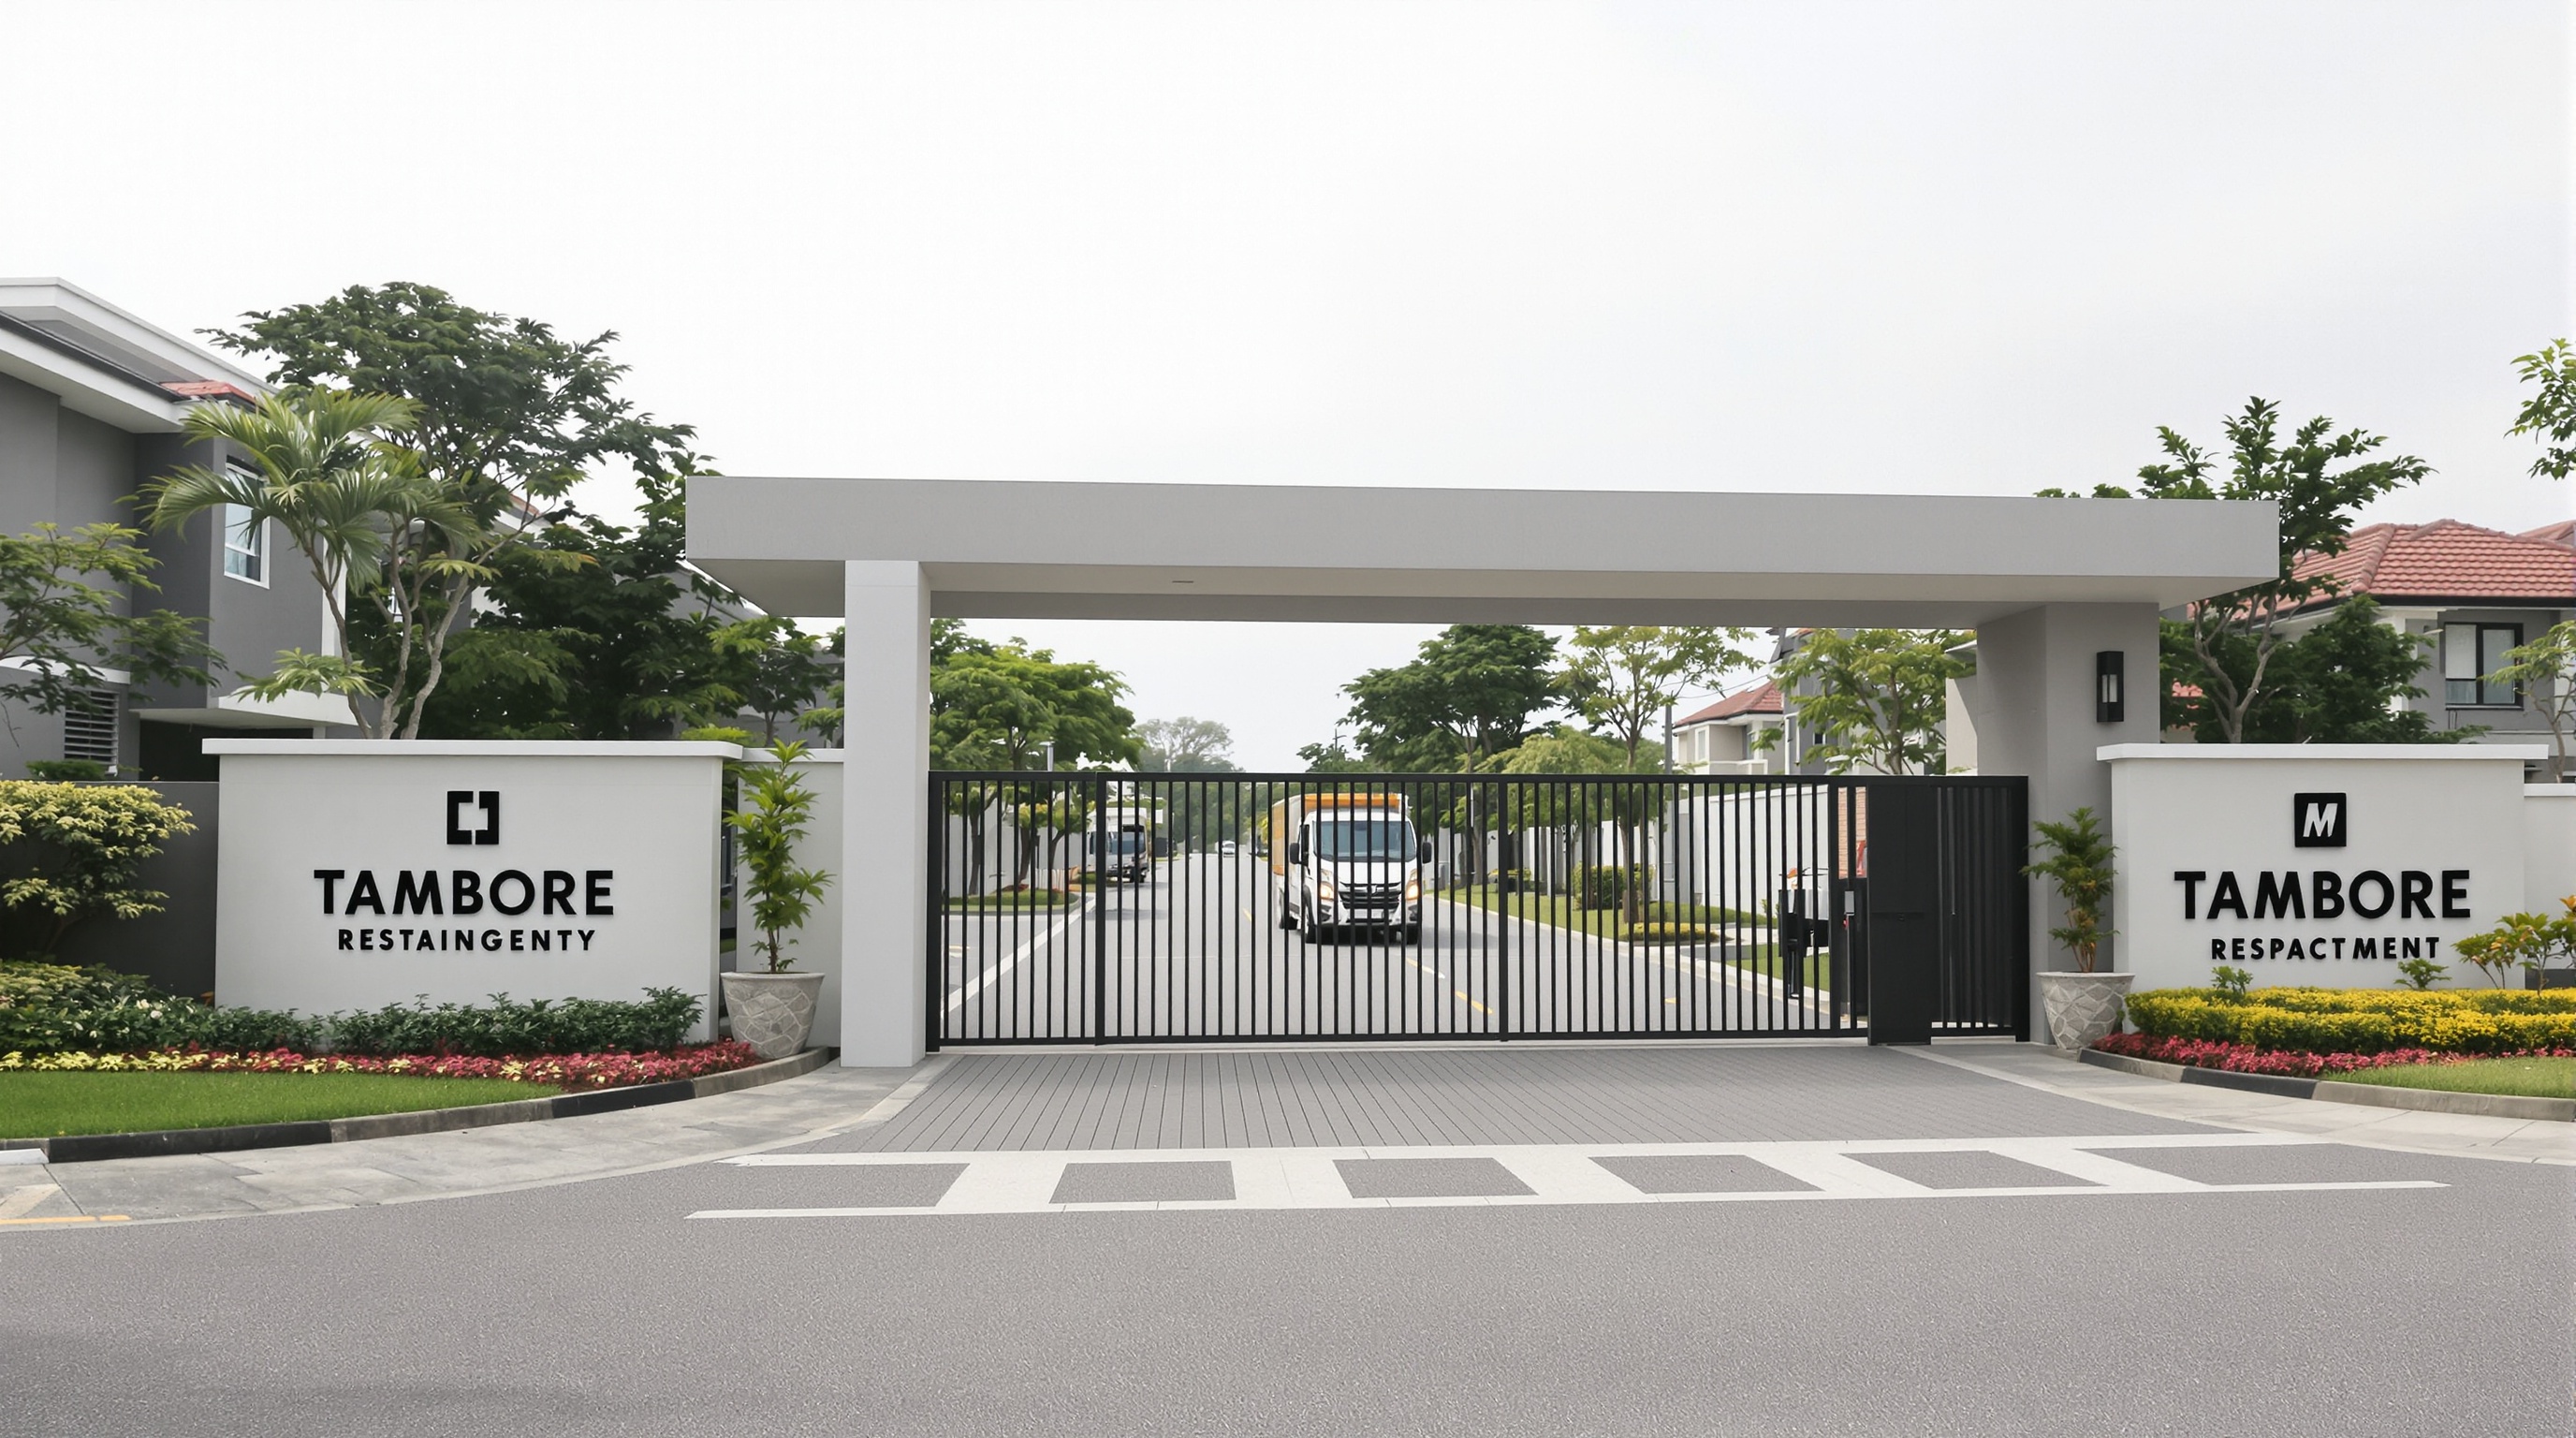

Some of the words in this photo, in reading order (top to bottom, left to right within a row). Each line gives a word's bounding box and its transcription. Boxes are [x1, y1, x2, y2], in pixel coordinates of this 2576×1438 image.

[2303, 802, 2338, 838] M
[313, 869, 614, 917] TAMBORE
[2174, 869, 2471, 920] TAMBORE
[338, 928, 595, 952] RESTAINGENTY
[2211, 936, 2440, 961] RESPACTMENT
